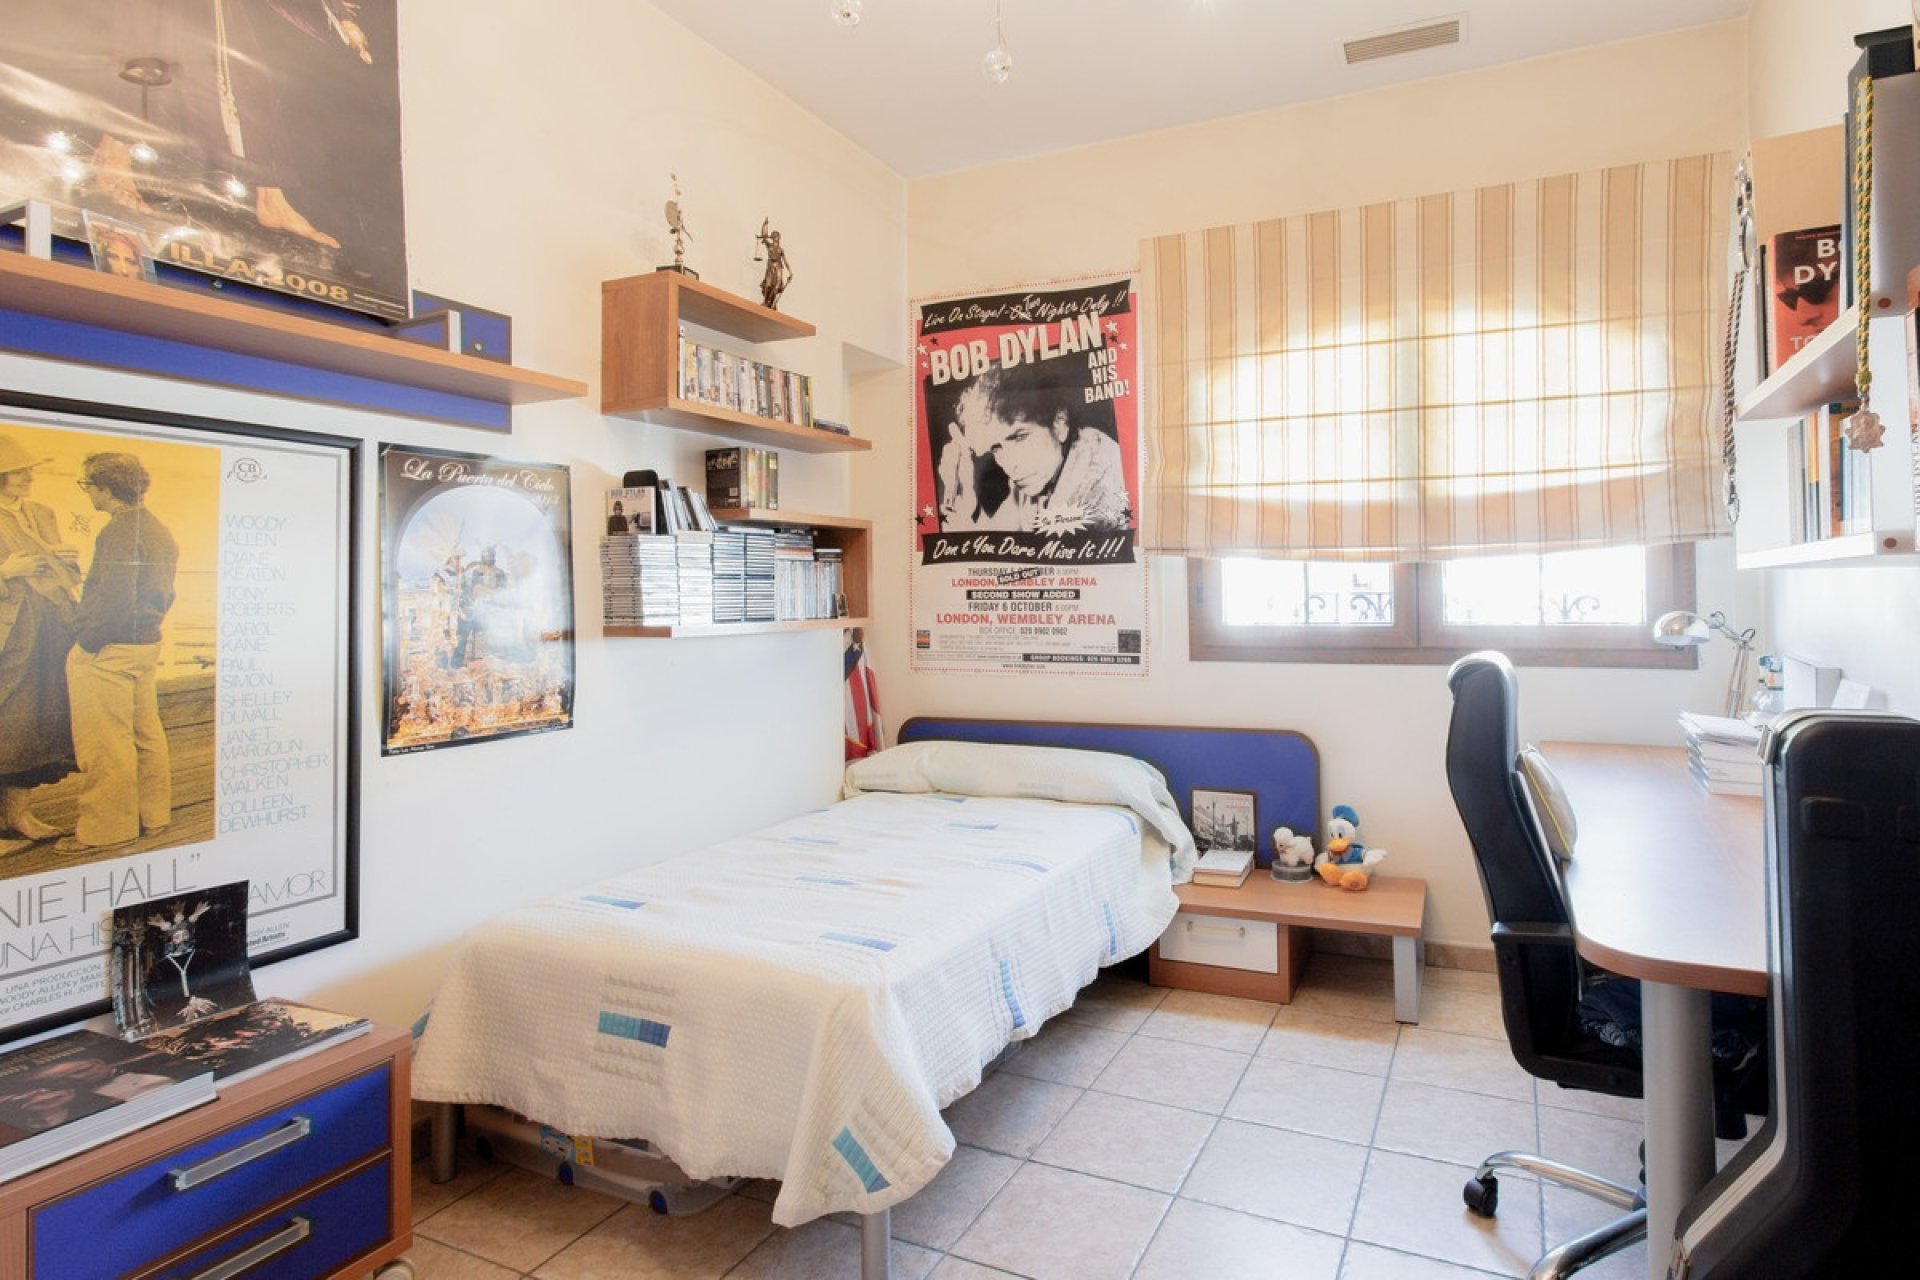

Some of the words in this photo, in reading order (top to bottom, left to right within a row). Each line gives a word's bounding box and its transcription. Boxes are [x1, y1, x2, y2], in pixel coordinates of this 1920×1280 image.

[924, 312, 945, 329] Live
[1035, 301, 1079, 322] Nights
[930, 340, 990, 387] BOB
[999, 311, 1103, 370] DYLAN
[1088, 348, 1118, 369] AND
[1092, 364, 1119, 385] HIS
[1084, 379, 1131, 404] BAND!
[400, 457, 432, 481] La
[438, 462, 493, 486] Puerta
[496, 474, 518, 488] del
[519, 470, 555, 490] Cielo
[226, 515, 287, 531] WOODY
[225, 532, 276, 546] ALLEN
[973, 535, 996, 555] You
[998, 536, 1036, 557] Dare
[1037, 540, 1077, 559] Miss
[224, 551, 270, 565] DIANE
[224, 567, 286, 582] KEATON
[967, 567, 1008, 577] THURSDAY
[1058, 577, 1098, 587] ARENA
[225, 586, 267, 600] TONY
[971, 590, 1008, 599] SECOND
[1011, 590, 1041, 599] SHOW
[1042, 590, 1076, 599] ADDED
[222, 602, 296, 617] ROBERTS
[967, 601, 999, 612] FRIDAY
[1002, 601, 1009, 612] 6
[1010, 601, 1053, 612] OCTOBER
[936, 613, 993, 626] LONDON,
[997, 613, 1063, 625] WEMBLEY
[1068, 613, 1117, 625] ARENA
[221, 622, 273, 637] CAROL
[221, 637, 266, 652] KANE
[221, 657, 258, 672] PAUL
[221, 673, 273, 690] SIMON
[221, 690, 293, 709] SHELLEY
[221, 707, 282, 727] DUVALL
[222, 726, 272, 746] JANET
[221, 739, 303, 761] MARGOLIN
[220, 755, 330, 782] CHRISTOPHER
[221, 774, 289, 796] WALKEN
[219, 793, 294, 818] COLLEEN
[219, 804, 310, 834] DEWHURST
